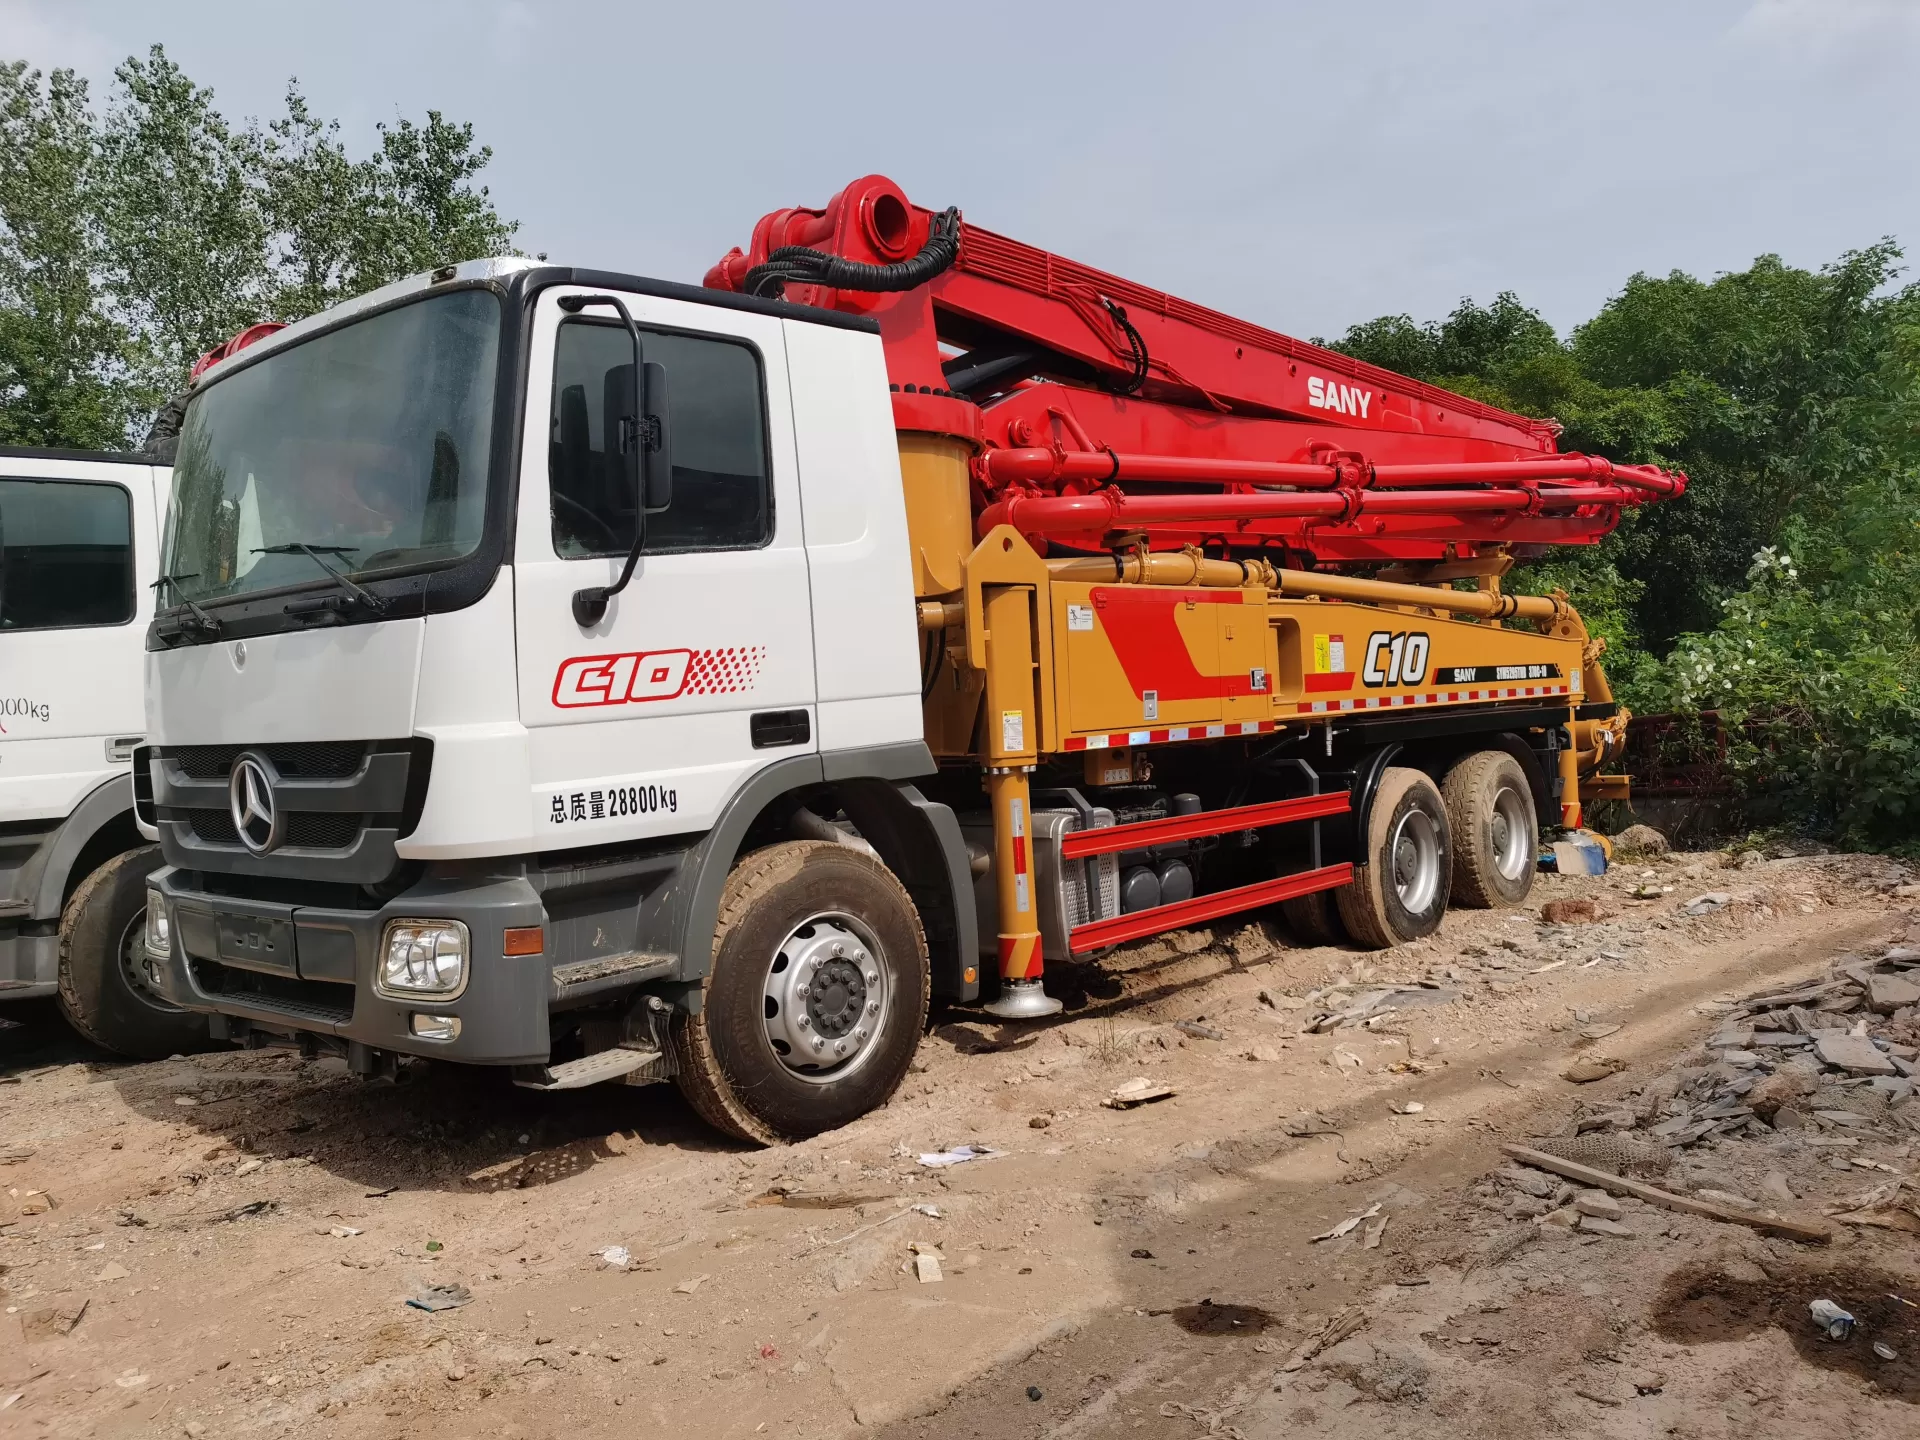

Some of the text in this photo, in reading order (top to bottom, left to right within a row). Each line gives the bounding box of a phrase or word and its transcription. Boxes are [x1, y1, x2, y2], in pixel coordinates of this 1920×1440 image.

[1308, 376, 1371, 419] SANY
[552, 648, 693, 708] C10
[1362, 631, 1430, 688] C10
[1453, 667, 1476, 682] SANY
